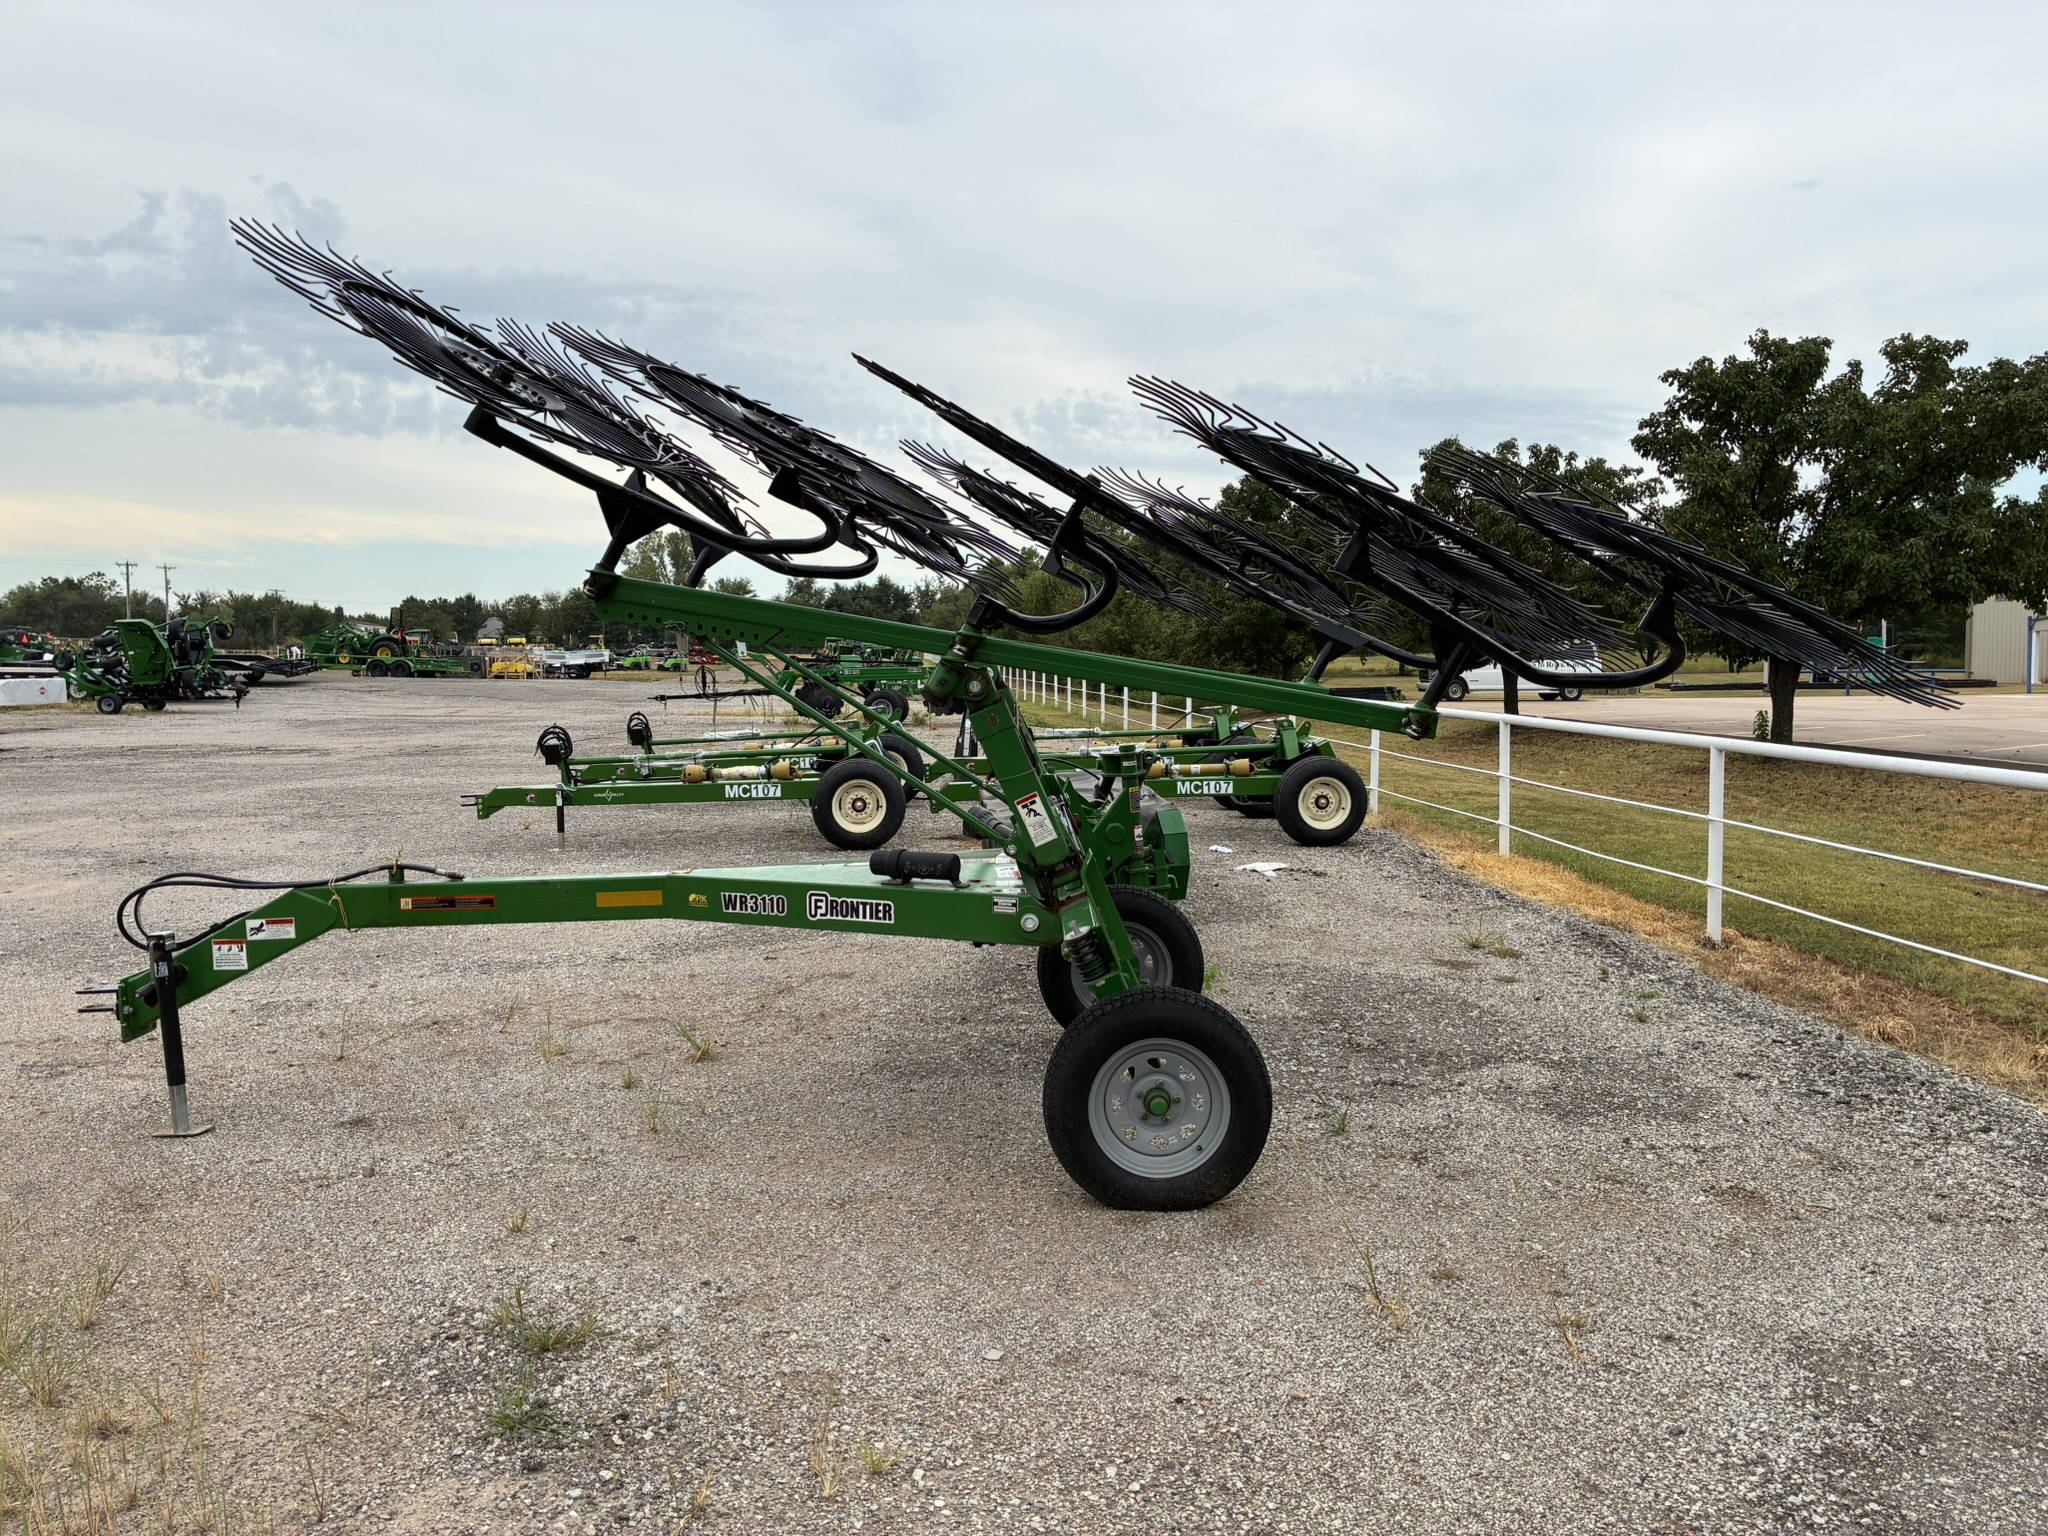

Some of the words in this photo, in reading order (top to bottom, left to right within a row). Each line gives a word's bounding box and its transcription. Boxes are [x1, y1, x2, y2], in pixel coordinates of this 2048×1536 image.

[725, 784, 780, 798] MC107
[1177, 781, 1232, 794] MC107
[721, 893, 786, 915] WR3110
[807, 891, 894, 922] FRONTIER
